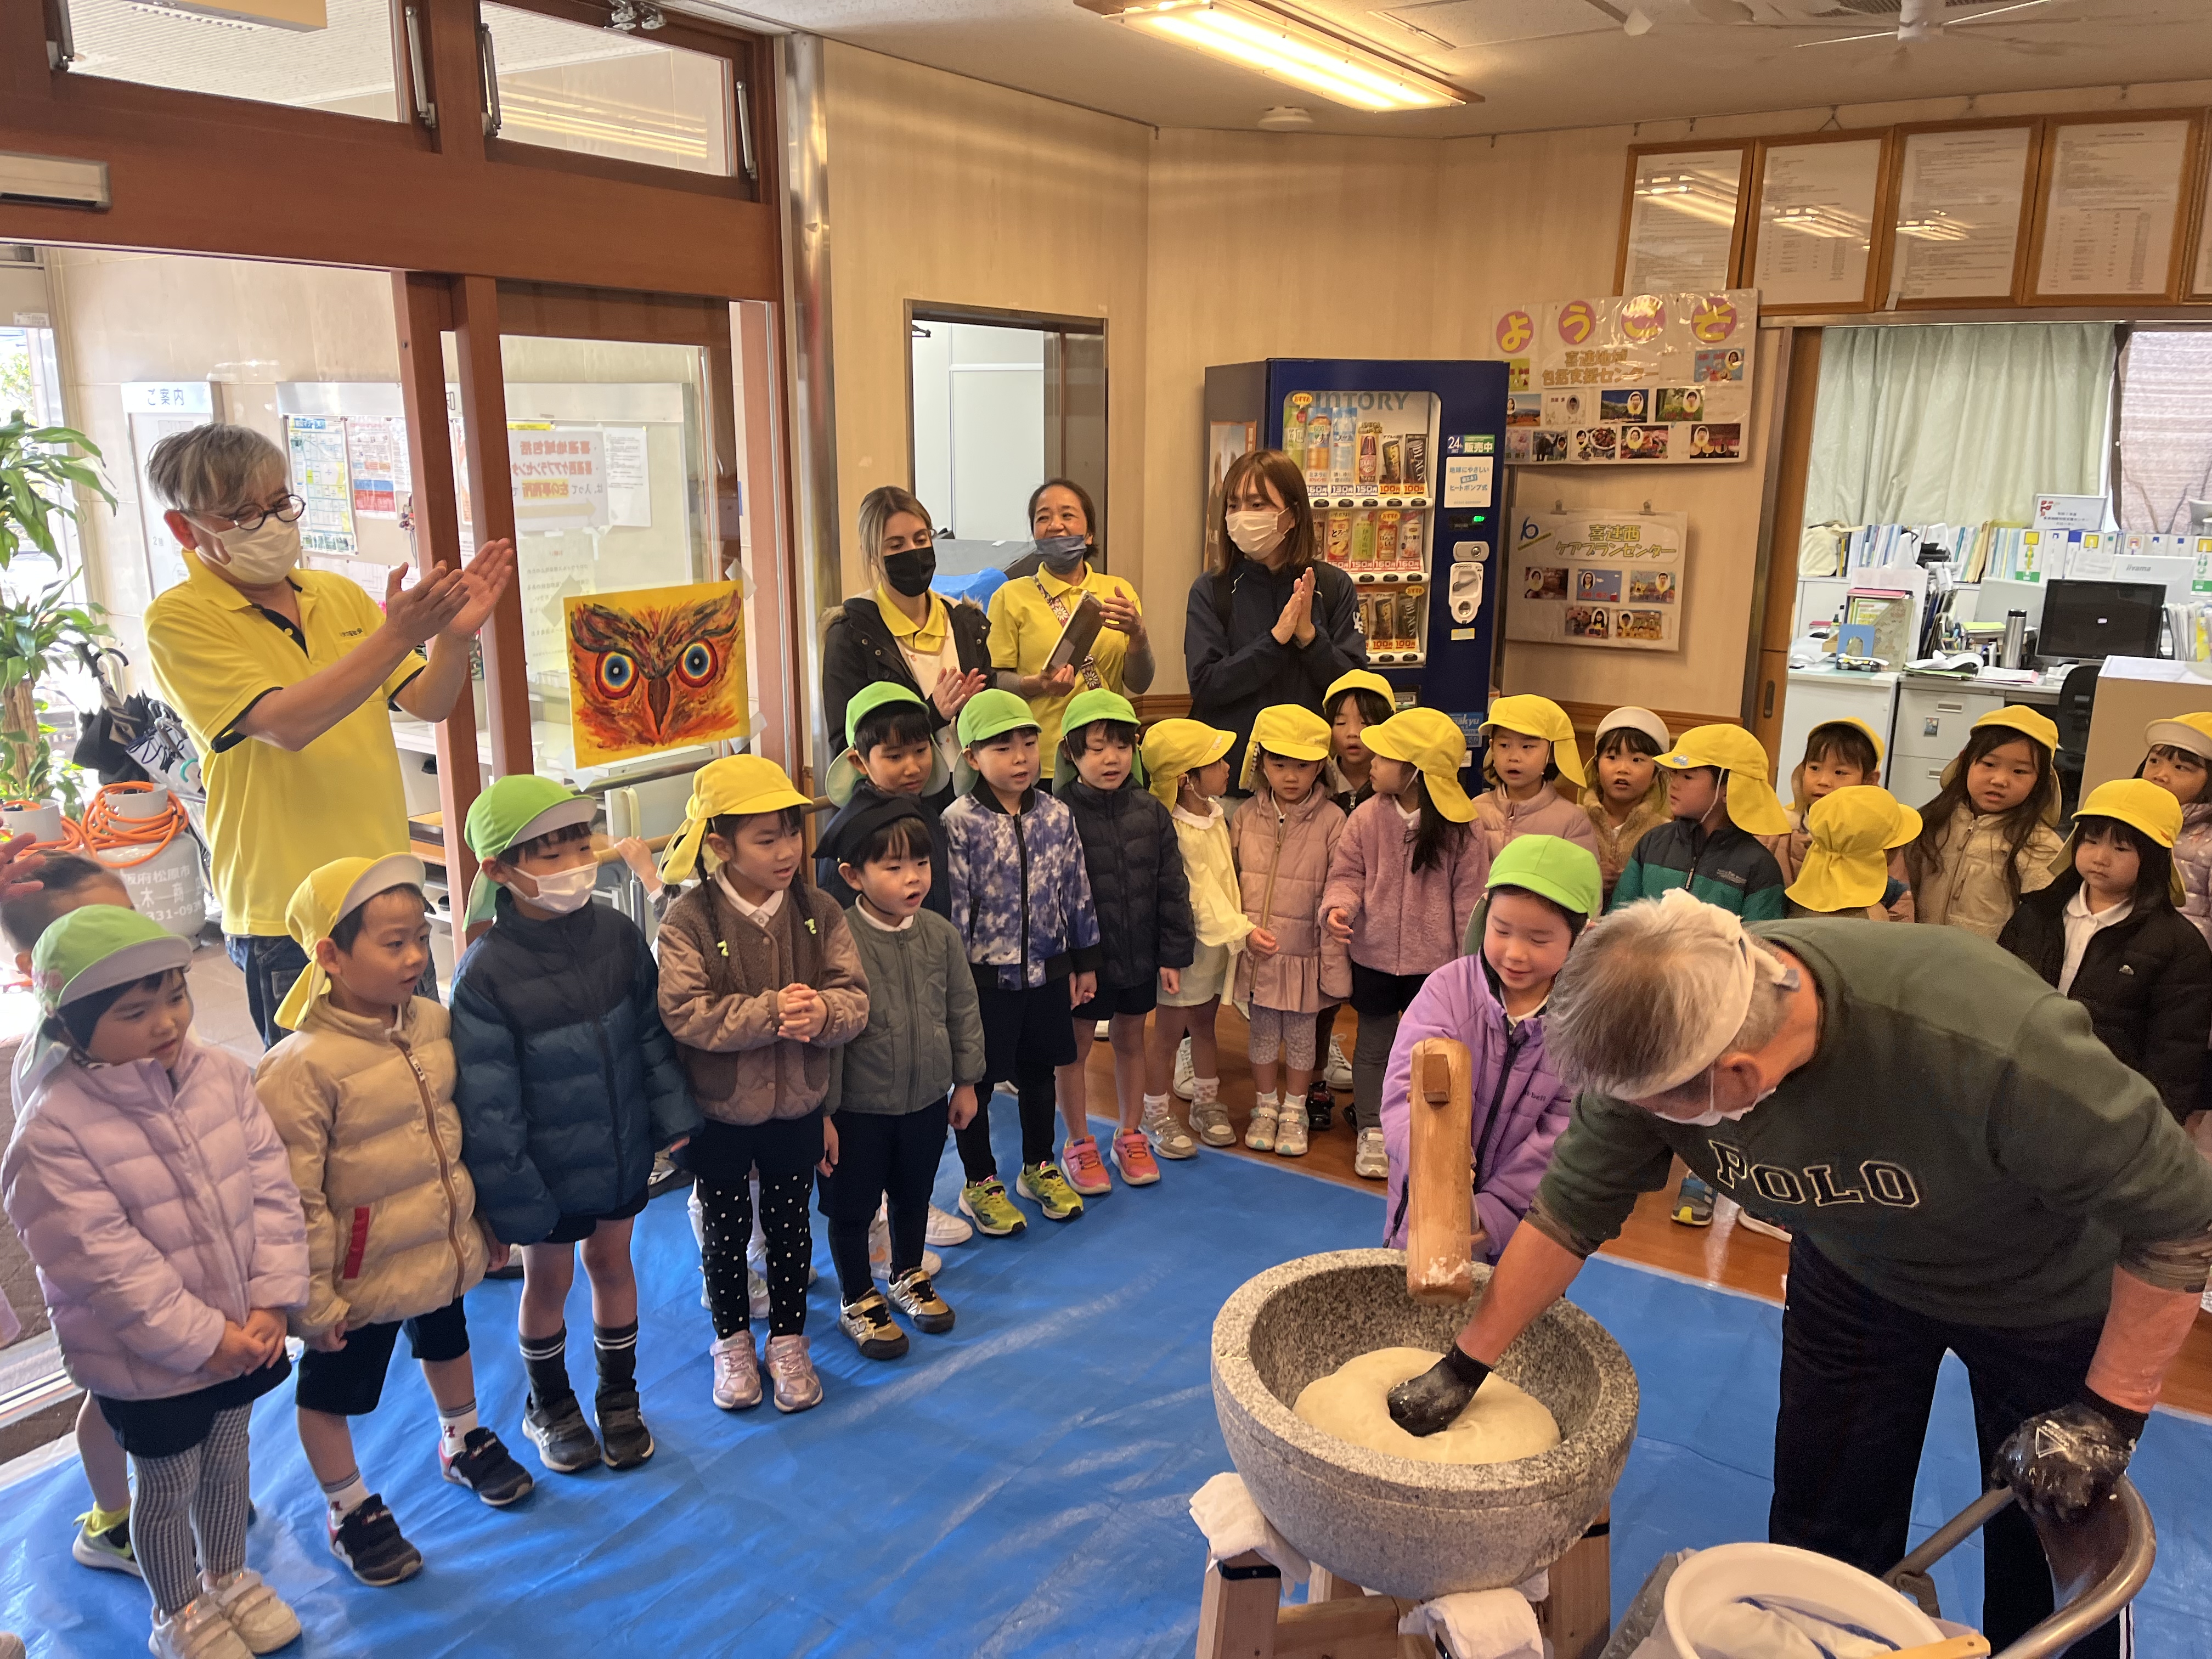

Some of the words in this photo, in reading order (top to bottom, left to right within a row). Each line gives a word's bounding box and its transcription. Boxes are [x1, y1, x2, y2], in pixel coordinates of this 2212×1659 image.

[148, 387, 184, 405] ご案内
[1315, 392, 1410, 411] NTORY
[1464, 442, 1493, 453] 販売中
[1412, 443, 1425, 482] BLACK
[1588, 524, 1641, 542] 喜連西
[1555, 541, 1677, 558] ケアプランセンター
[1708, 1139, 1920, 1208] POLO
